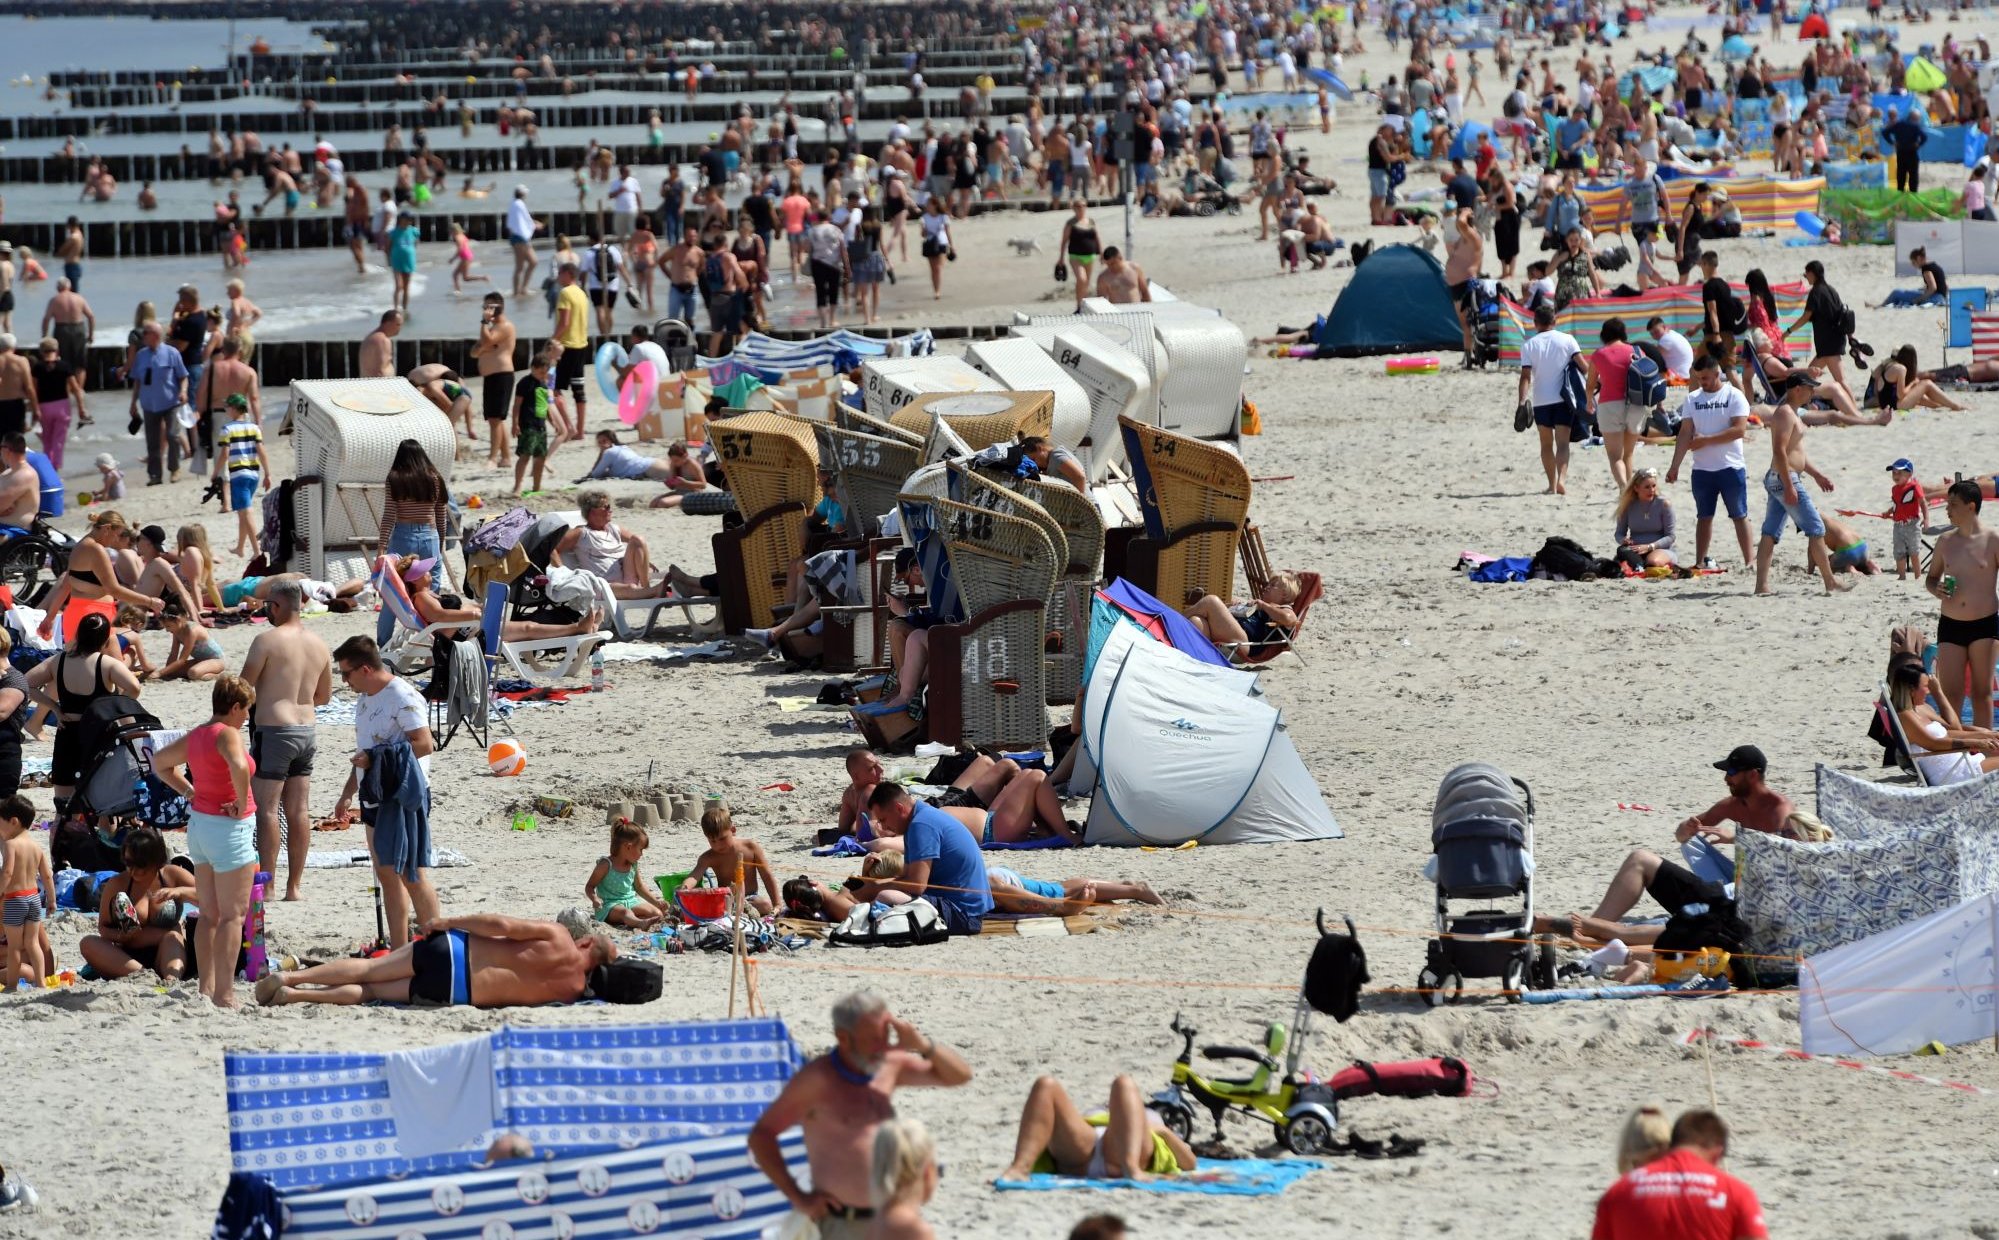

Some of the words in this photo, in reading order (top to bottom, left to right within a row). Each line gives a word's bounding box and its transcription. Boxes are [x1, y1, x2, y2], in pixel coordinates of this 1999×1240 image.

[1060, 349, 1081, 369] 64
[868, 374, 883, 396] 6
[721, 432, 753, 460] 57
[841, 439, 881, 467] 55
[1152, 435, 1176, 457] 54
[961, 636, 1010, 684] 48
[1159, 728, 1212, 742] Quechua
